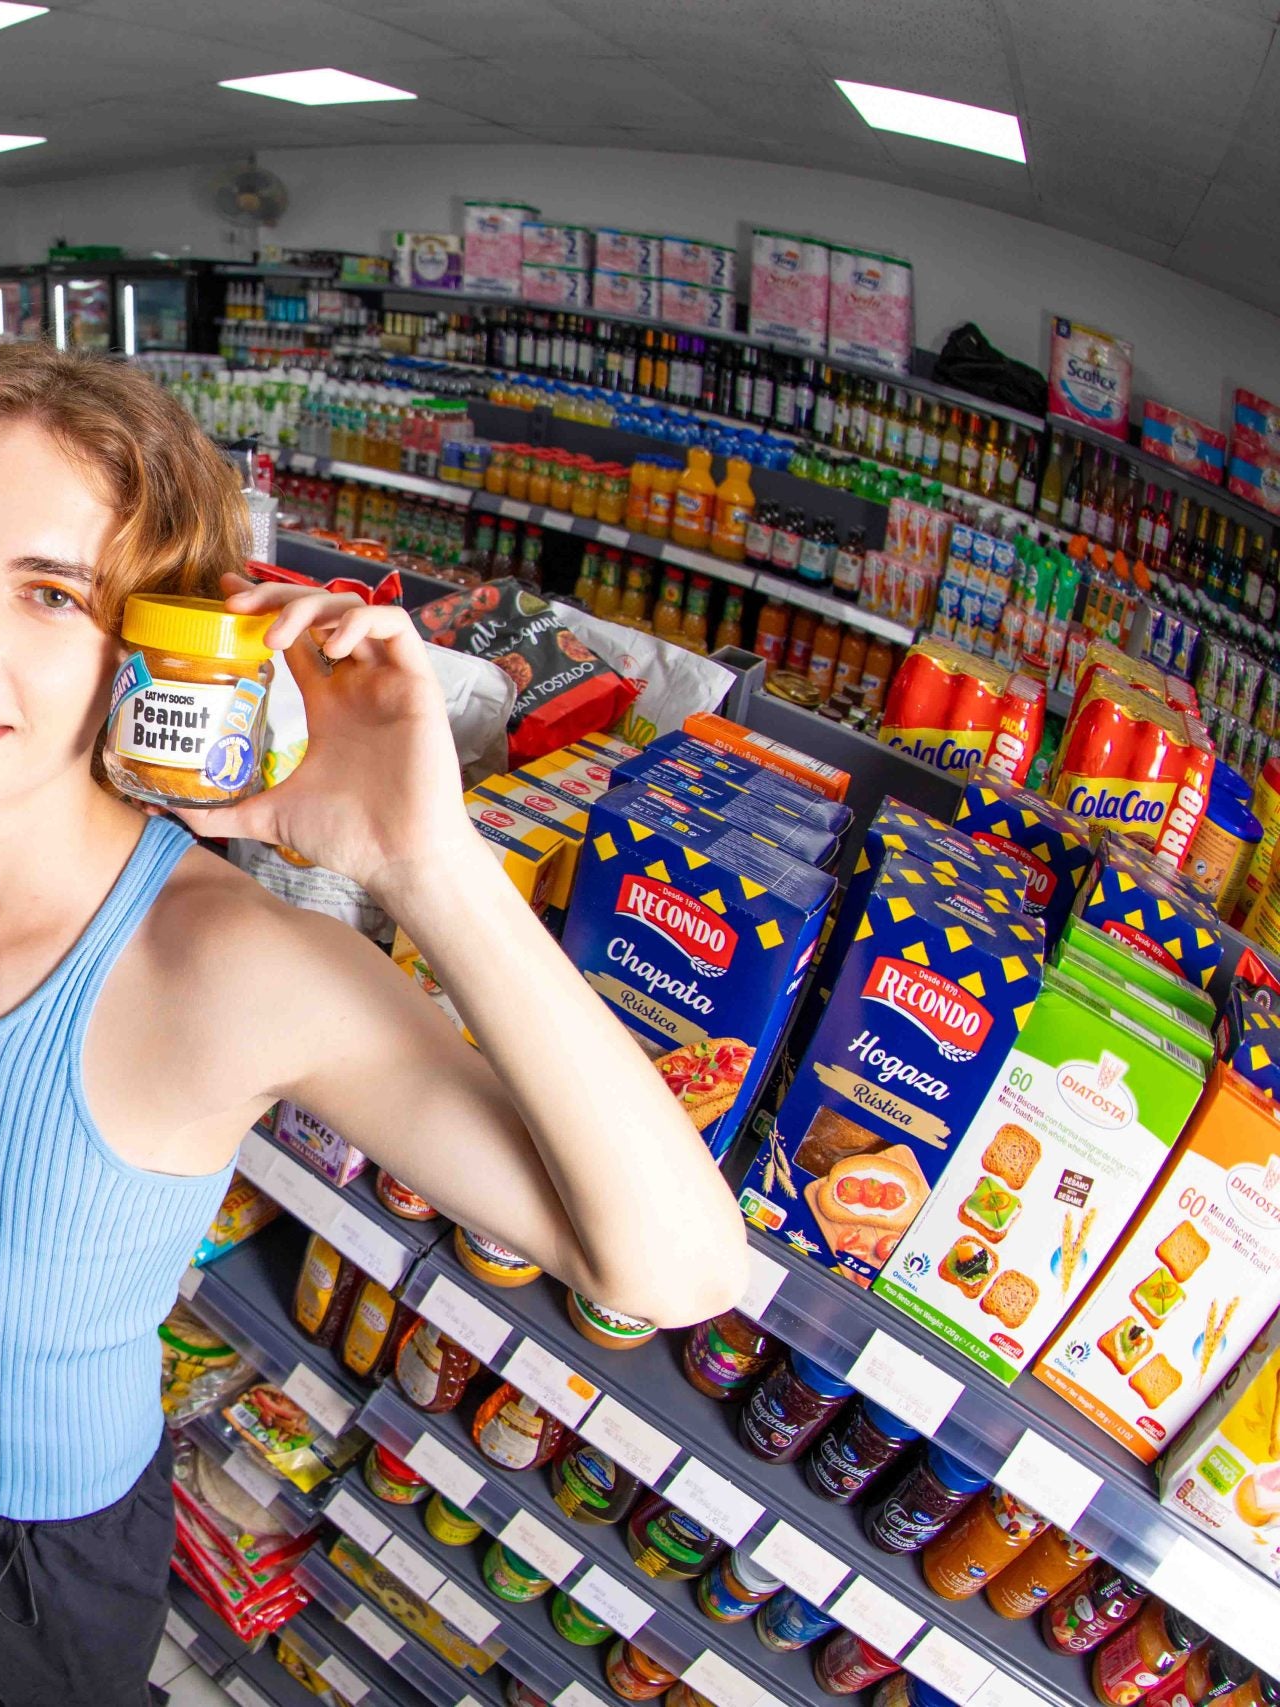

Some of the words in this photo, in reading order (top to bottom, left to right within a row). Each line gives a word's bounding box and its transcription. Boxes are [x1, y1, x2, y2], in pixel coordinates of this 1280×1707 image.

[1068, 359, 1117, 391] Scottex
[145, 690, 156, 701] EAT
[157, 692, 169, 703] MY
[169, 694, 195, 706] SOCKS
[510, 689, 538, 718] PAN
[534, 661, 595, 698] TOSTADO
[133, 697, 210, 730] Peanut
[133, 722, 206, 754] Butter
[526, 795, 557, 812] Ortiz
[1067, 785, 1165, 823] ColaCao
[479, 823, 511, 843] TOSTAS
[482, 811, 515, 829] Ortiz
[662, 887, 684, 903] Desde
[684, 898, 702, 913] 1870
[944, 896, 990, 923] Hogaza
[627, 882, 727, 953] RECONDO
[1134, 932, 1151, 949] Desde
[1150, 943, 1163, 958] 1870
[607, 937, 715, 1015] Chapata
[918, 970, 941, 986] Desde
[941, 981, 959, 997] 1870
[621, 989, 678, 1034] Rústica
[876, 965, 981, 1036] RECONDO
[848, 1030, 950, 1101] Hogaza
[1009, 1066, 1033, 1093] 60
[853, 1083, 913, 1126] Rústica
[997, 1094, 1012, 1109] Mini
[1011, 1103, 1034, 1124] Toasts
[1002, 1085, 1018, 1098] Mini
[1016, 1094, 1045, 1118] Biscotes
[1061, 1075, 1126, 1123] DIATOSTA
[1178, 1187, 1207, 1219] 60
[1208, 1203, 1227, 1223] Mini
[1225, 1216, 1260, 1249] Biscotes
[1200, 1215, 1234, 1244] Regular
[1231, 1239, 1250, 1258] Mini
[1249, 1252, 1272, 1275] Toast
[892, 1270, 919, 1293] ORIGINAL
[360, 1300, 382, 1324] miel
[979, 1350, 991, 1362] OZ
[751, 1387, 800, 1436] Temporada
[747, 1418, 769, 1446] CEREZAS
[822, 1433, 871, 1479] Temporada
[816, 1463, 839, 1491] CEREZAS
